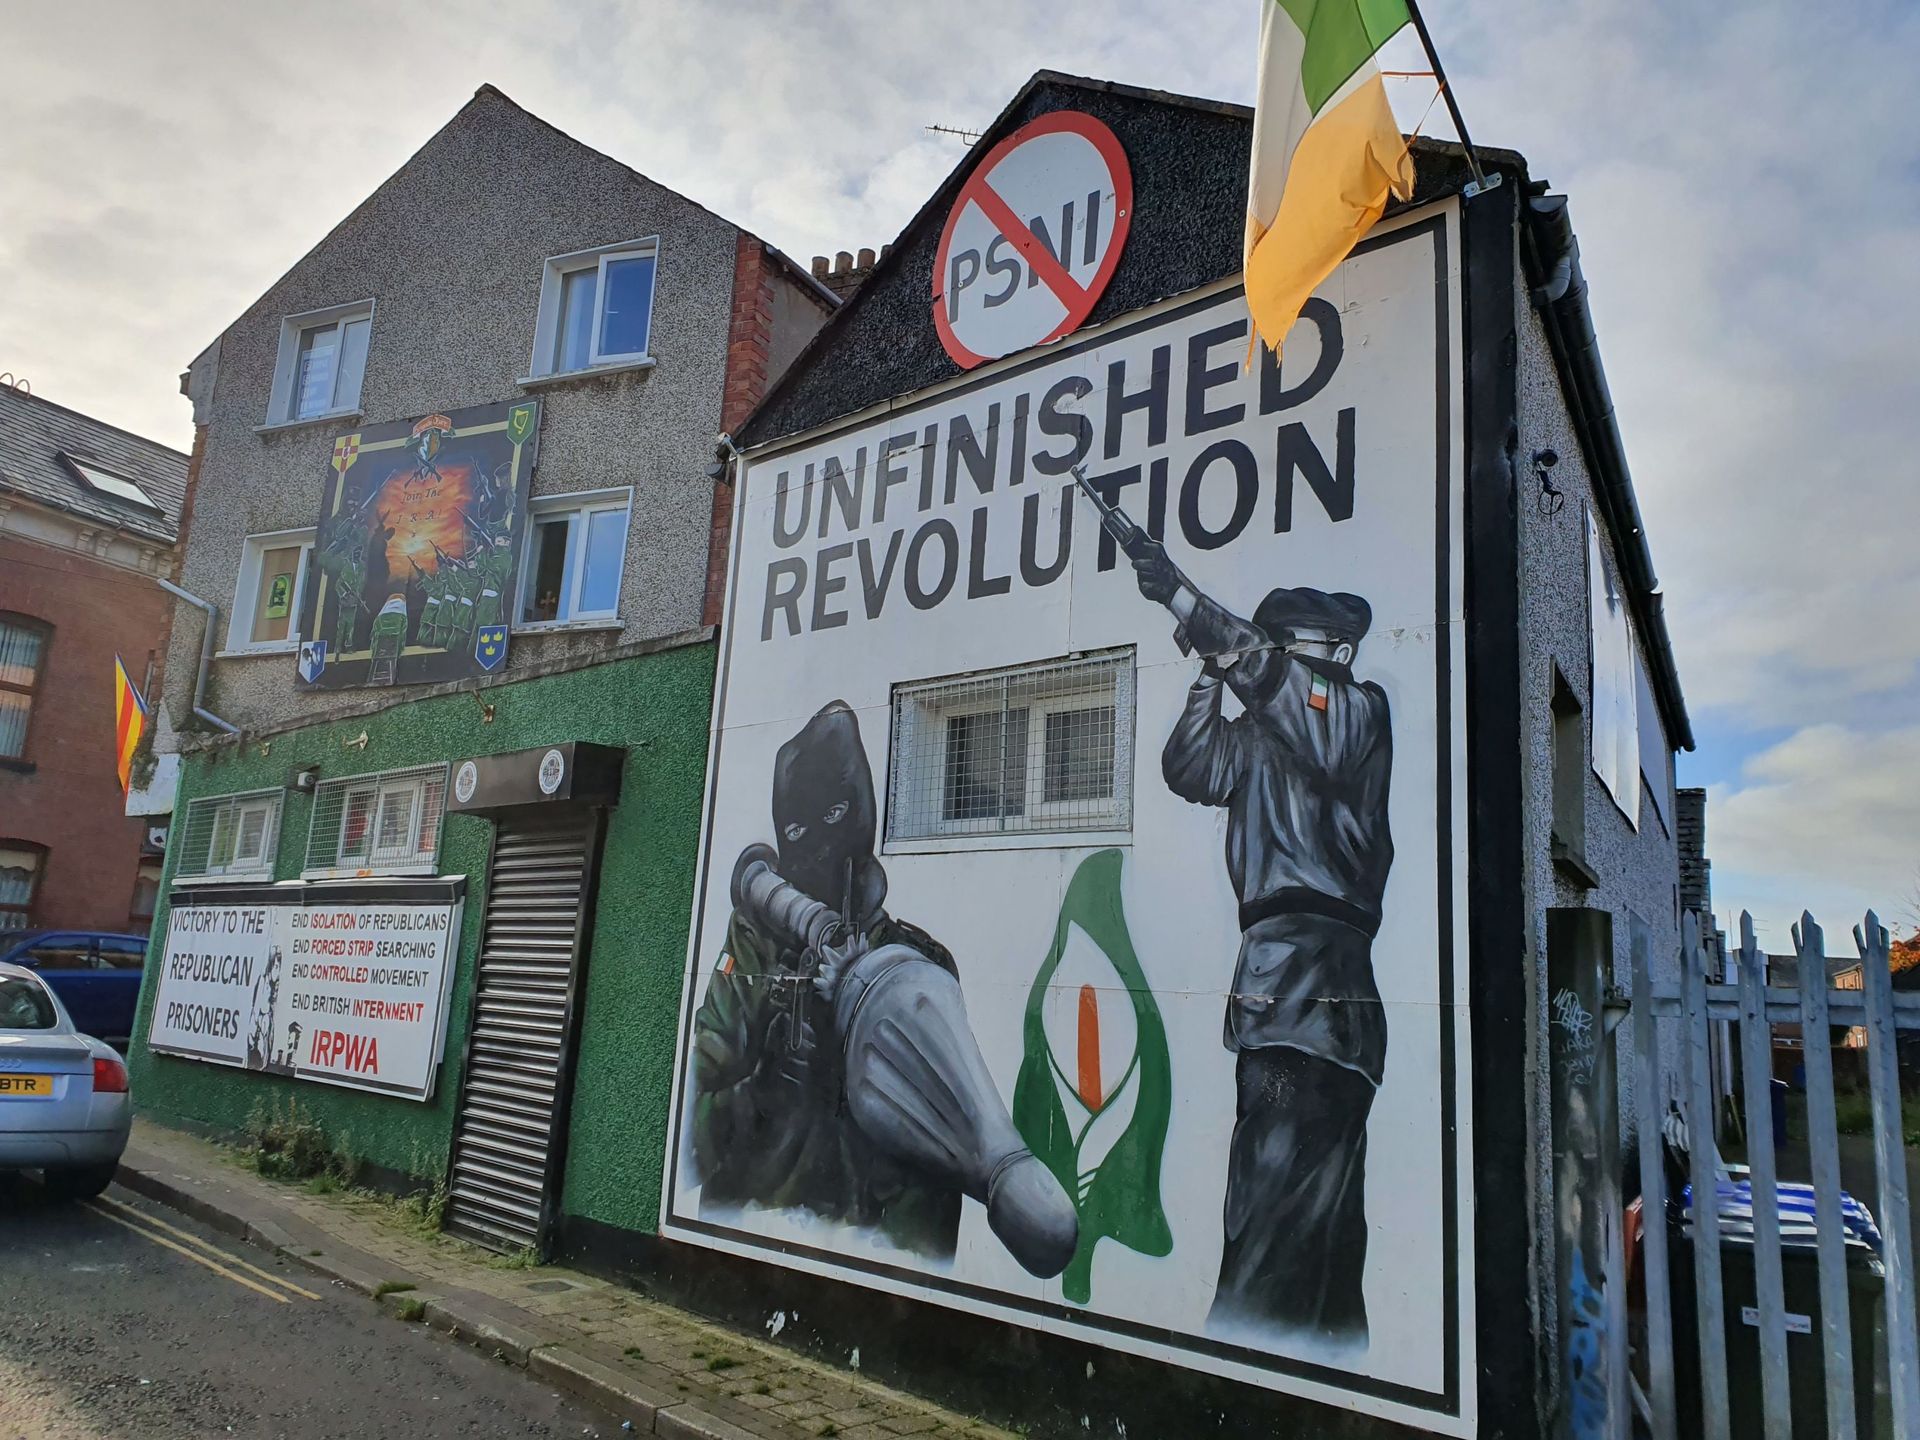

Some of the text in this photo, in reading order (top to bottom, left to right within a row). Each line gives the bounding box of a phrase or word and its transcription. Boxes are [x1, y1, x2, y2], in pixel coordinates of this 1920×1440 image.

[949, 189, 1101, 326] PSNI
[772, 297, 1344, 549] UNFINISHED
[760, 407, 1356, 643] REVOLUTION
[173, 910, 266, 934] VICTORY TO THE
[292, 912, 448, 931] END ISOLATION OF REPUBLICANS
[293, 939, 436, 959] END FORCED STRIP SEARCHING
[169, 952, 254, 987] REPUBLICAN
[291, 963, 429, 987] END CONTROLLED MOVEMENT
[165, 1001, 240, 1040] PRISONERS
[291, 993, 425, 1023] END BRITISH INTERNMENT
[309, 1028, 380, 1075] IRPWA
